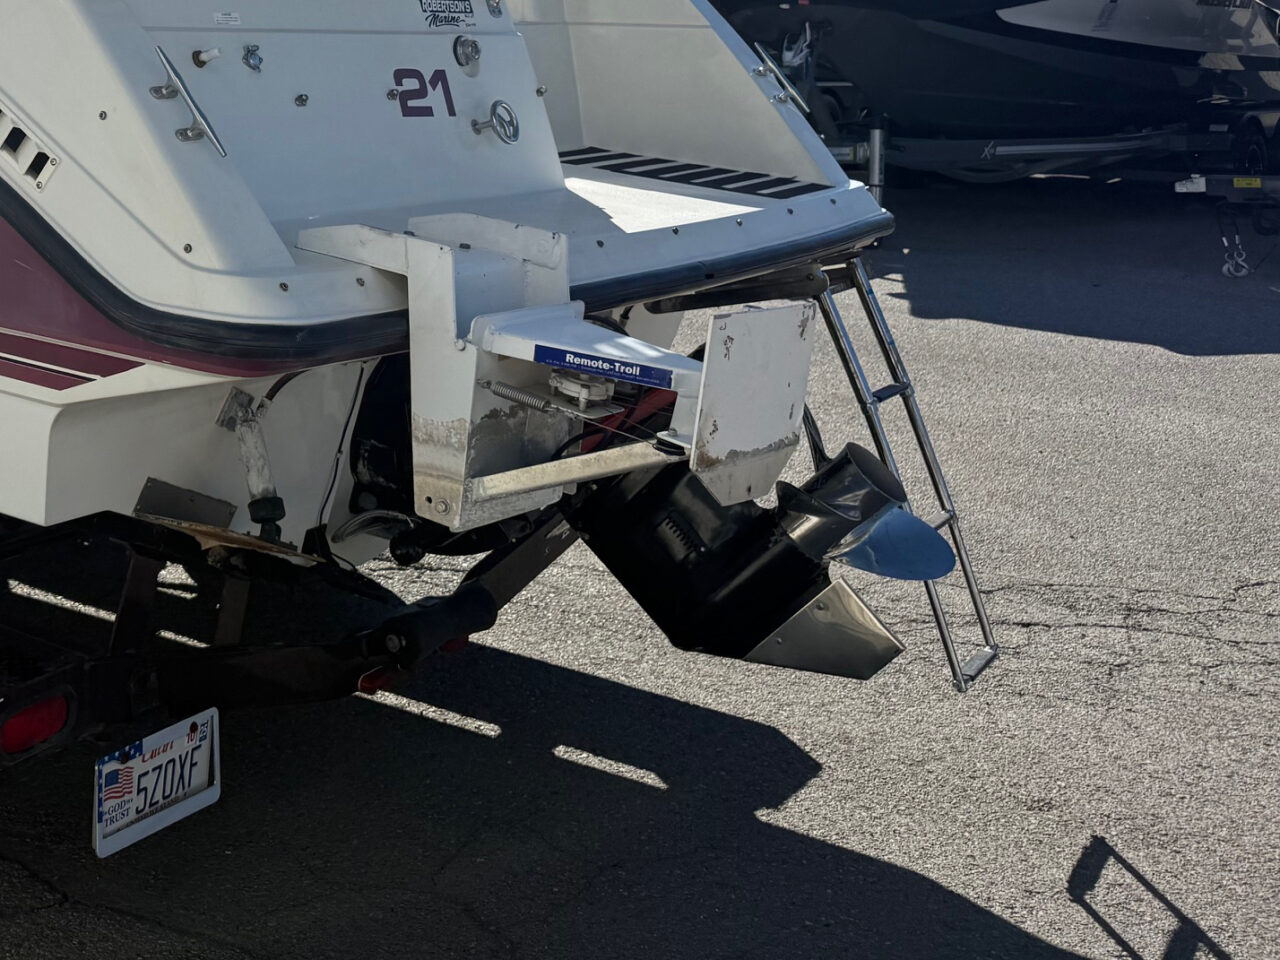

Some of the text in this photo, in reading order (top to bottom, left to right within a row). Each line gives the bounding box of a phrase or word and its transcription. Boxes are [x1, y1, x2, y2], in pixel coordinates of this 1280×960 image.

[425, 13, 466, 28] Marine
[393, 68, 456, 117] 21
[566, 353, 640, 376] Remote-Troll
[104, 807, 131, 828] TRUST
[108, 799, 126, 816] GOD
